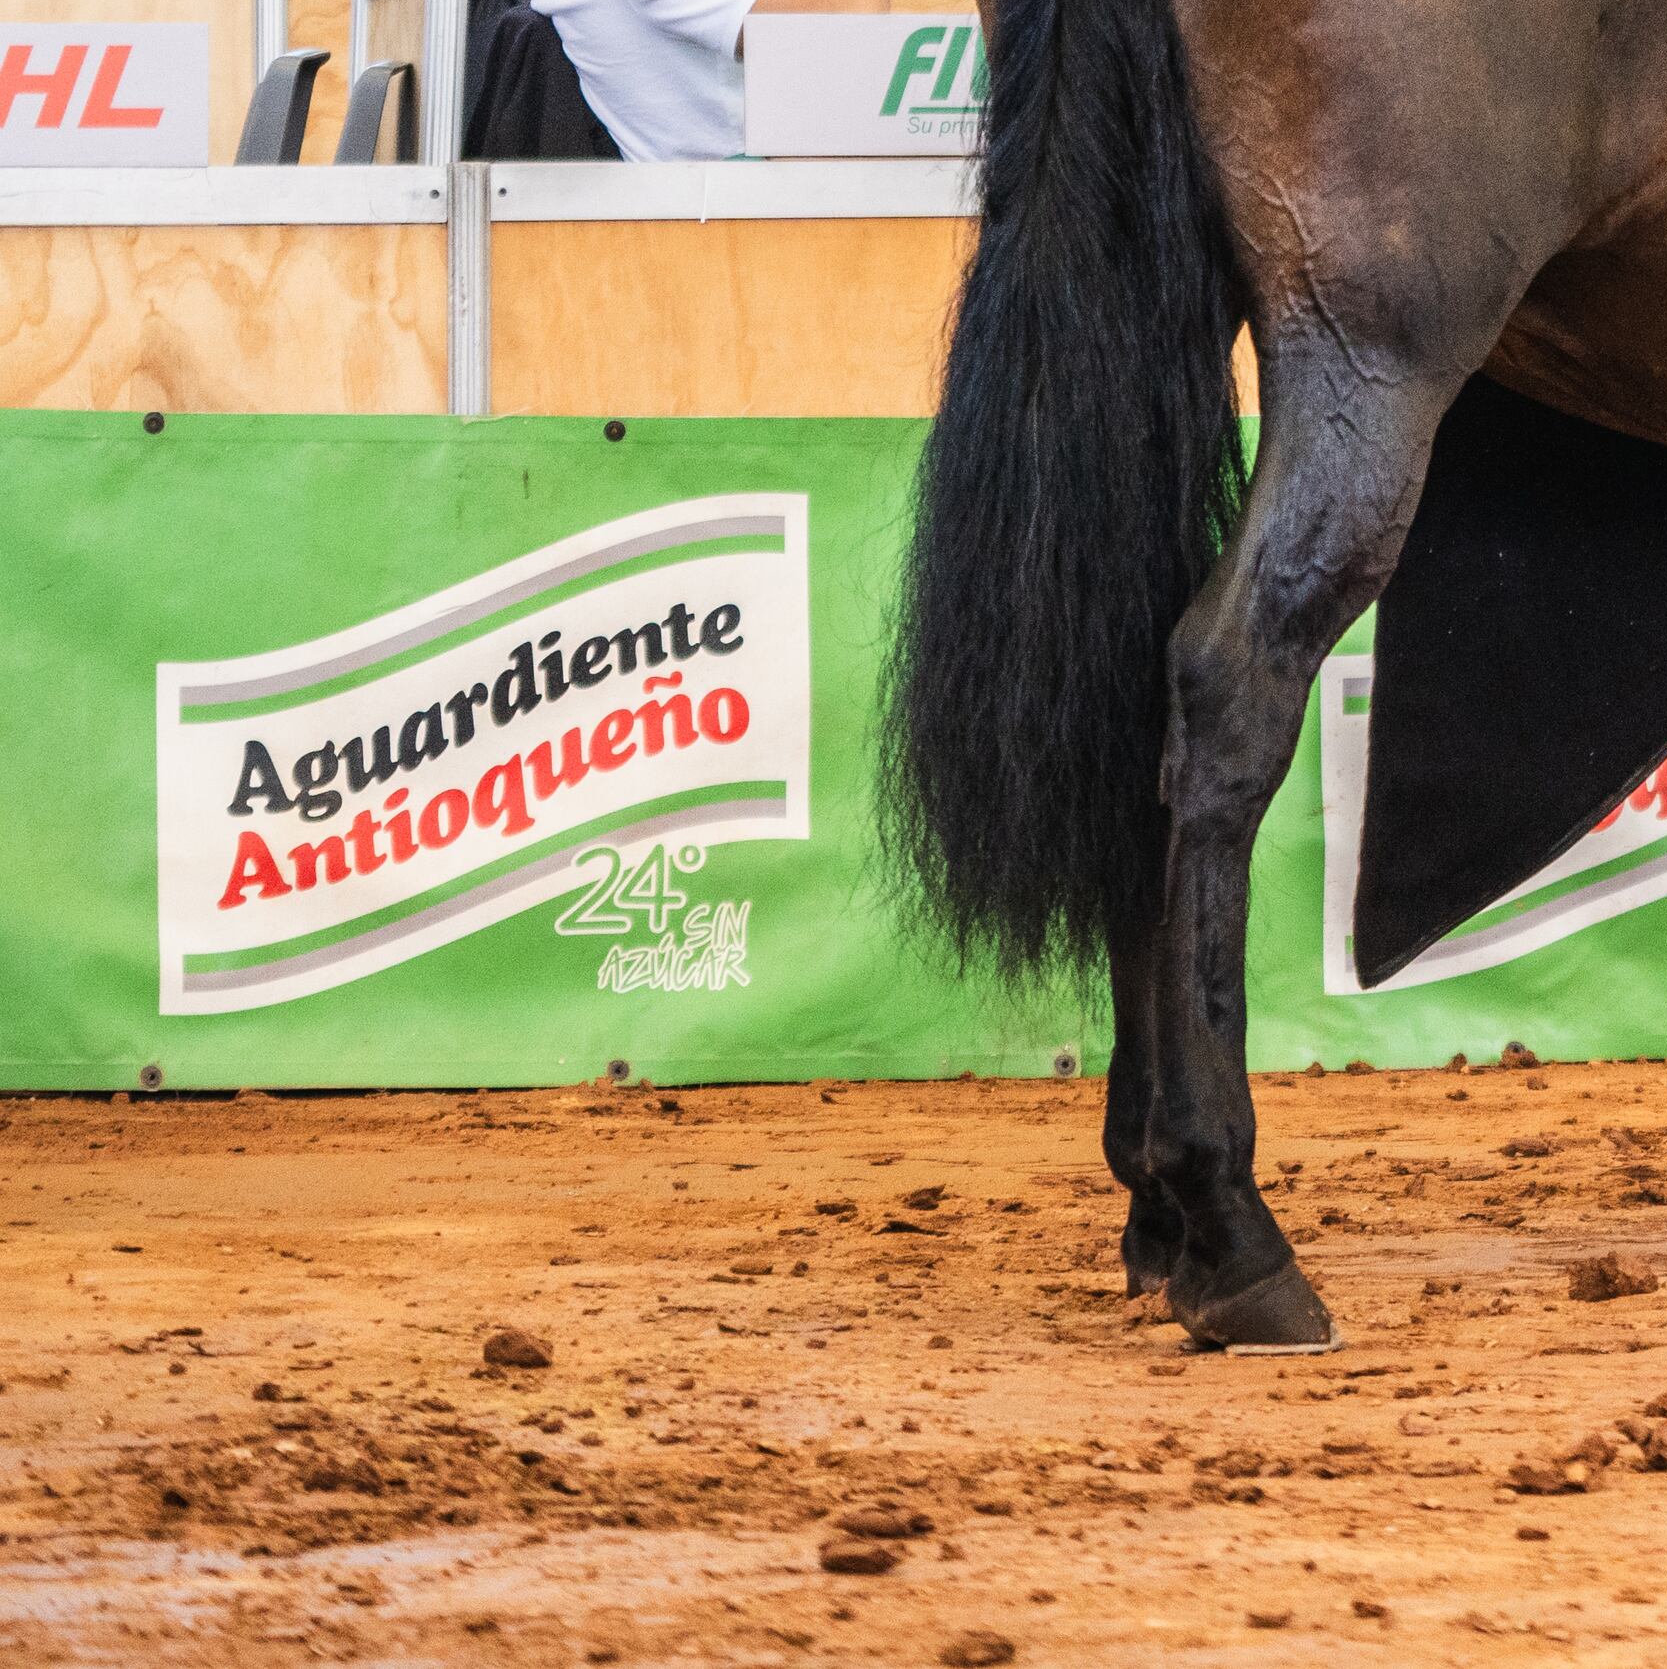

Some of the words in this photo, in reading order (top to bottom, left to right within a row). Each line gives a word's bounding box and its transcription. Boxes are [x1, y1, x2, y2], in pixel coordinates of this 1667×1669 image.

[907, 116, 932, 134] Su
[226, 602, 744, 823] Aguardiente
[217, 673, 751, 912] Antioqueño
[683, 902, 751, 952] SIN
[597, 938, 751, 992] AZÚCAR
